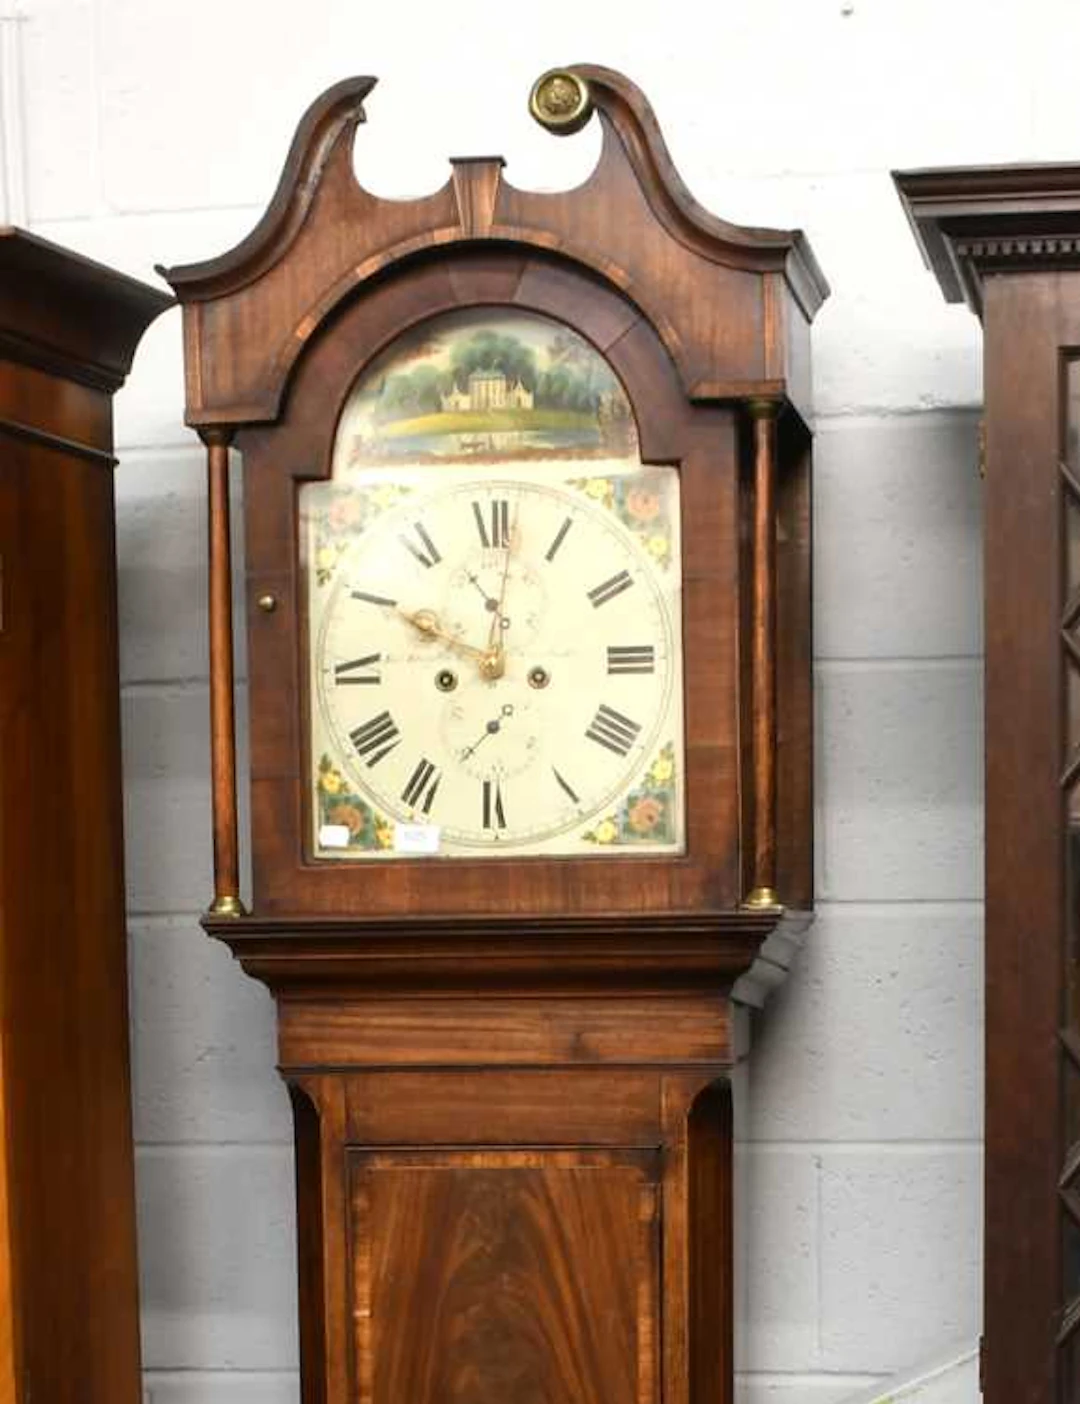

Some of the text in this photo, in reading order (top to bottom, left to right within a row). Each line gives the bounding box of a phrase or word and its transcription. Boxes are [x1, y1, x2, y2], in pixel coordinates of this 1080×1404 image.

[544, 517, 574, 563] I
[587, 569, 636, 609] II
[606, 645, 655, 675] III
